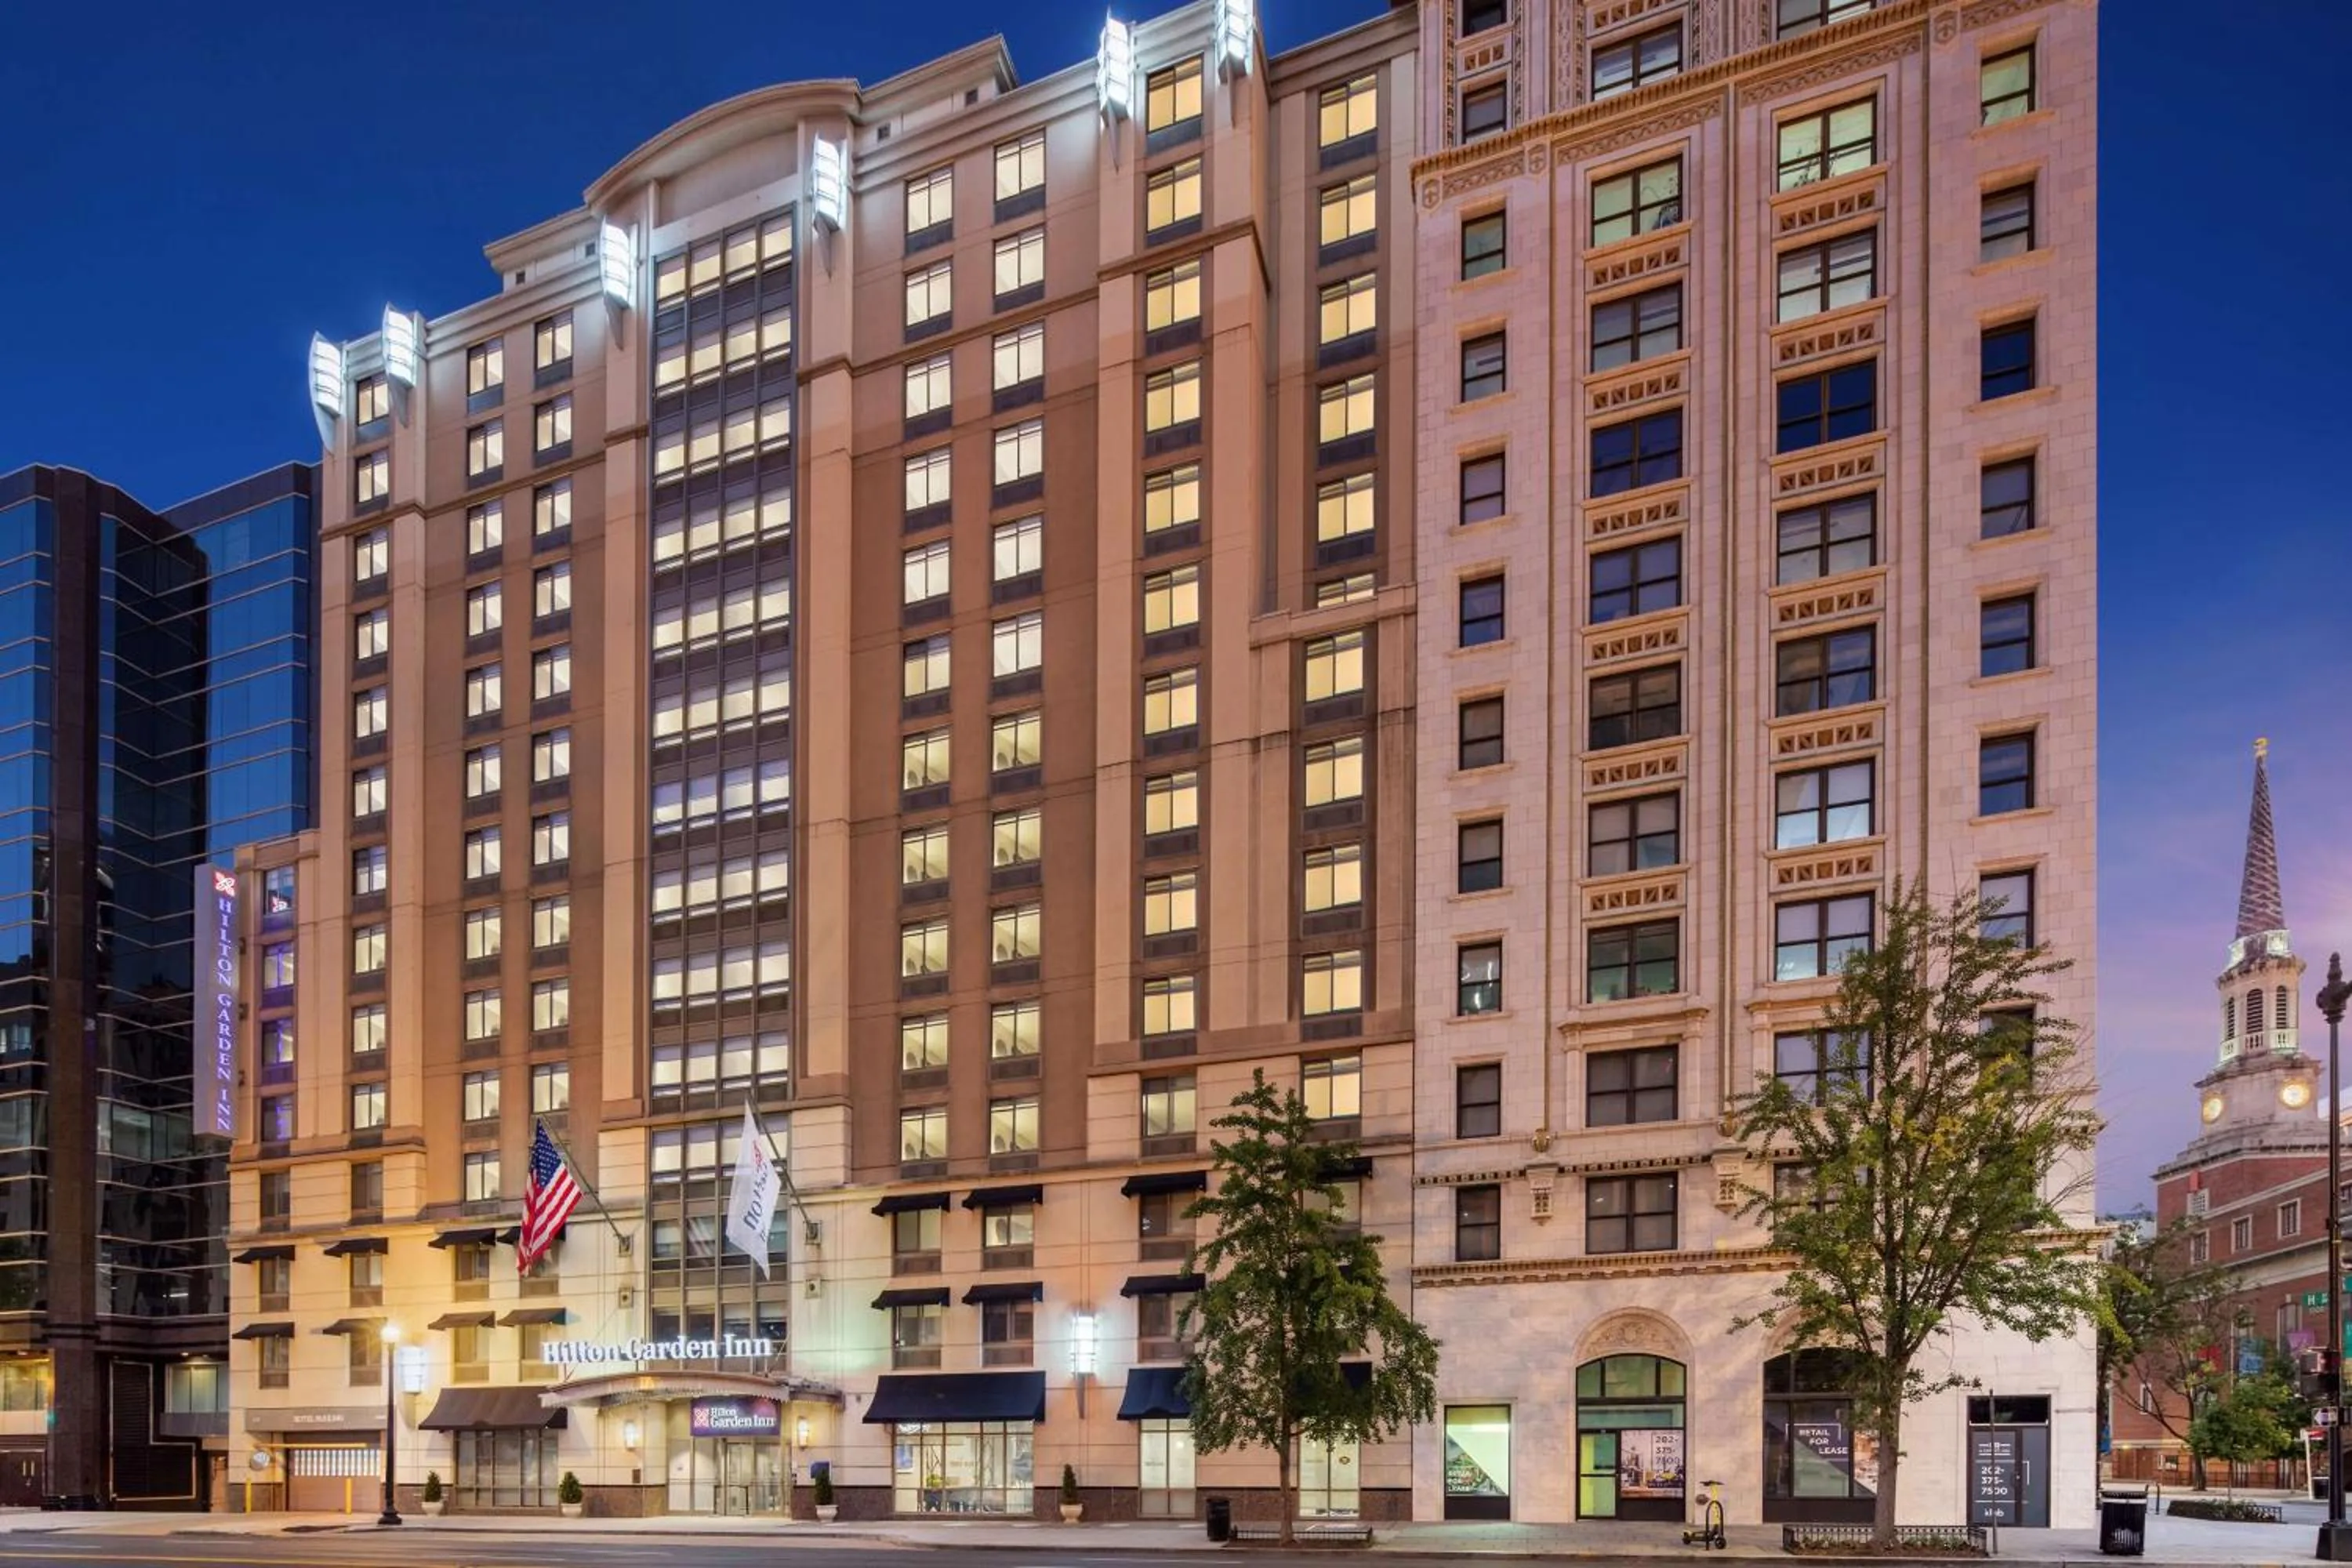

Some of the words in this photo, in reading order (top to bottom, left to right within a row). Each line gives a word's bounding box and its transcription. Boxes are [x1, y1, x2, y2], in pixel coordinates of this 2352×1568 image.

[218, 898, 233, 987] HILTON
[217, 993, 232, 1080] GARDEN
[217, 1089, 230, 1131] INN
[543, 1341, 621, 1364] Hilton
[627, 1335, 722, 1362] Garden
[724, 1333, 772, 1357] Inn
[710, 1407, 737, 1417] Hilton
[710, 1414, 752, 1427] Garden
[753, 1414, 775, 1426] Inn
[1981, 1466, 2004, 1475] 202-
[1981, 1486, 2008, 1495] 7500
